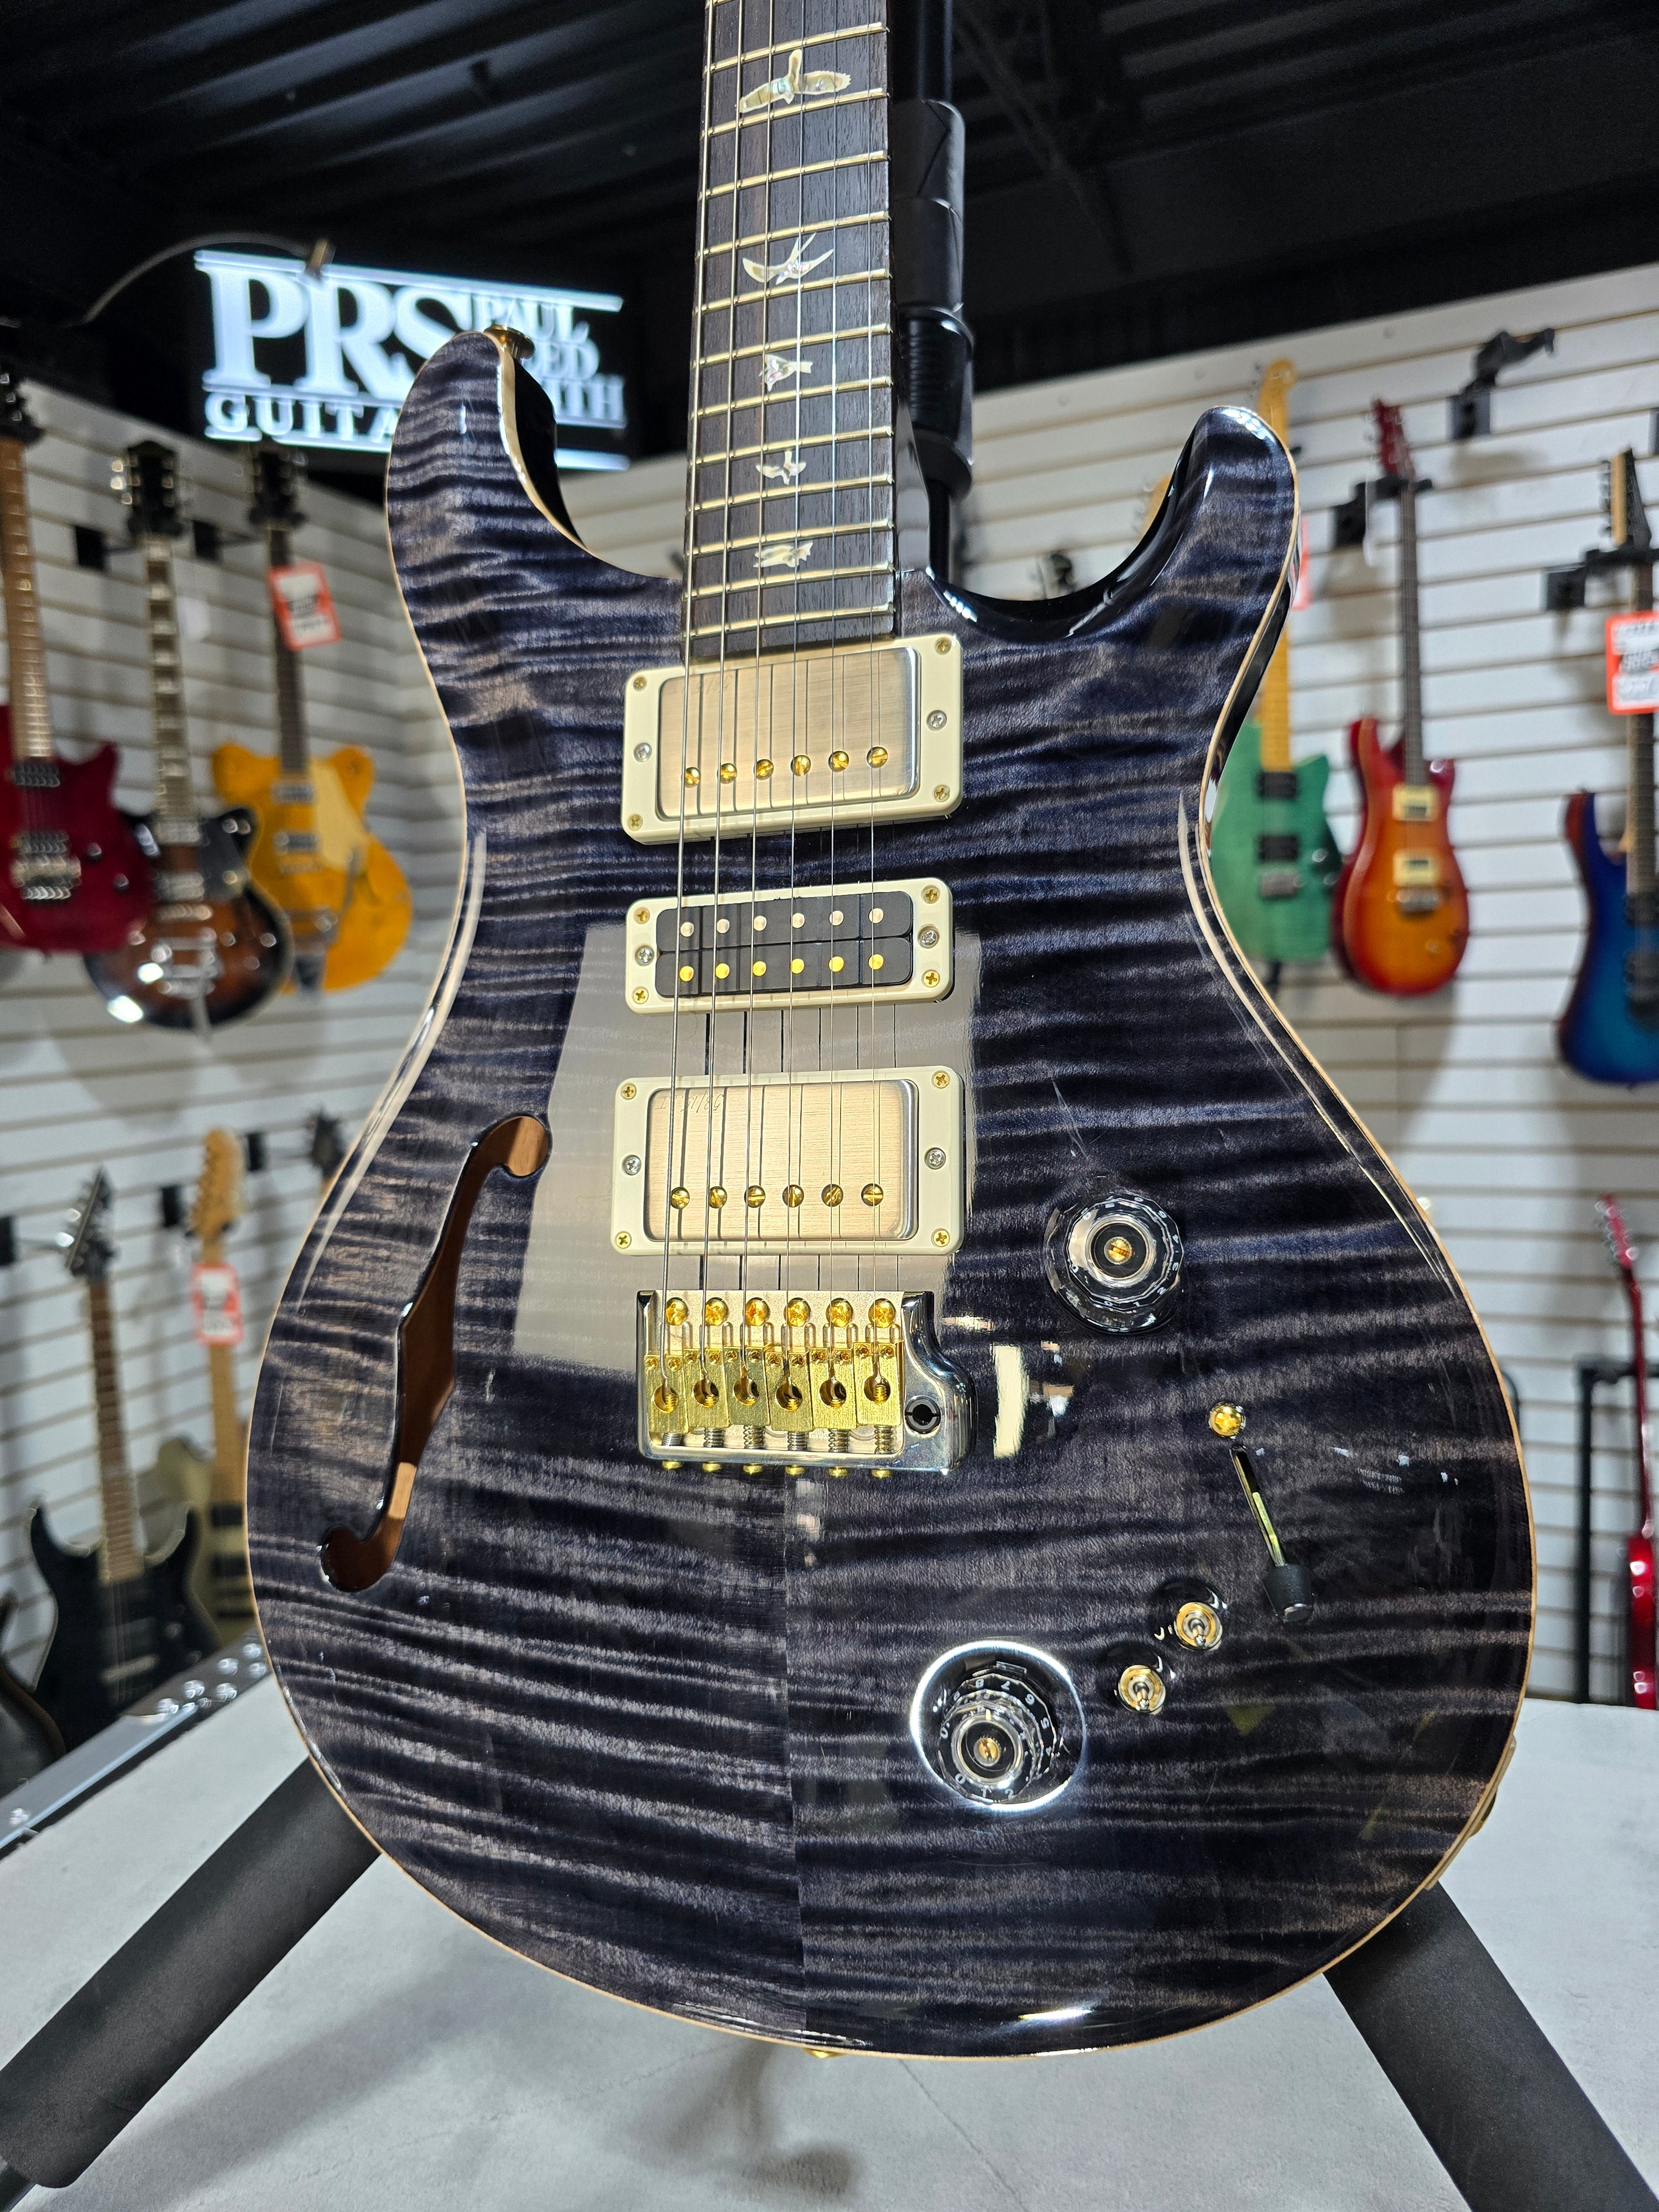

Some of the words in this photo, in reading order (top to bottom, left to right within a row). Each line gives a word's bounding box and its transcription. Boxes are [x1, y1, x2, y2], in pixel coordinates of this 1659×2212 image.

[196, 261, 472, 399] PRS
[205, 392, 398, 442] GUITA
[975, 1678, 984, 1689] 8
[1001, 1681, 1010, 1691] 7
[1040, 1717, 1050, 1730] 5
[954, 1773, 966, 1785] 0
